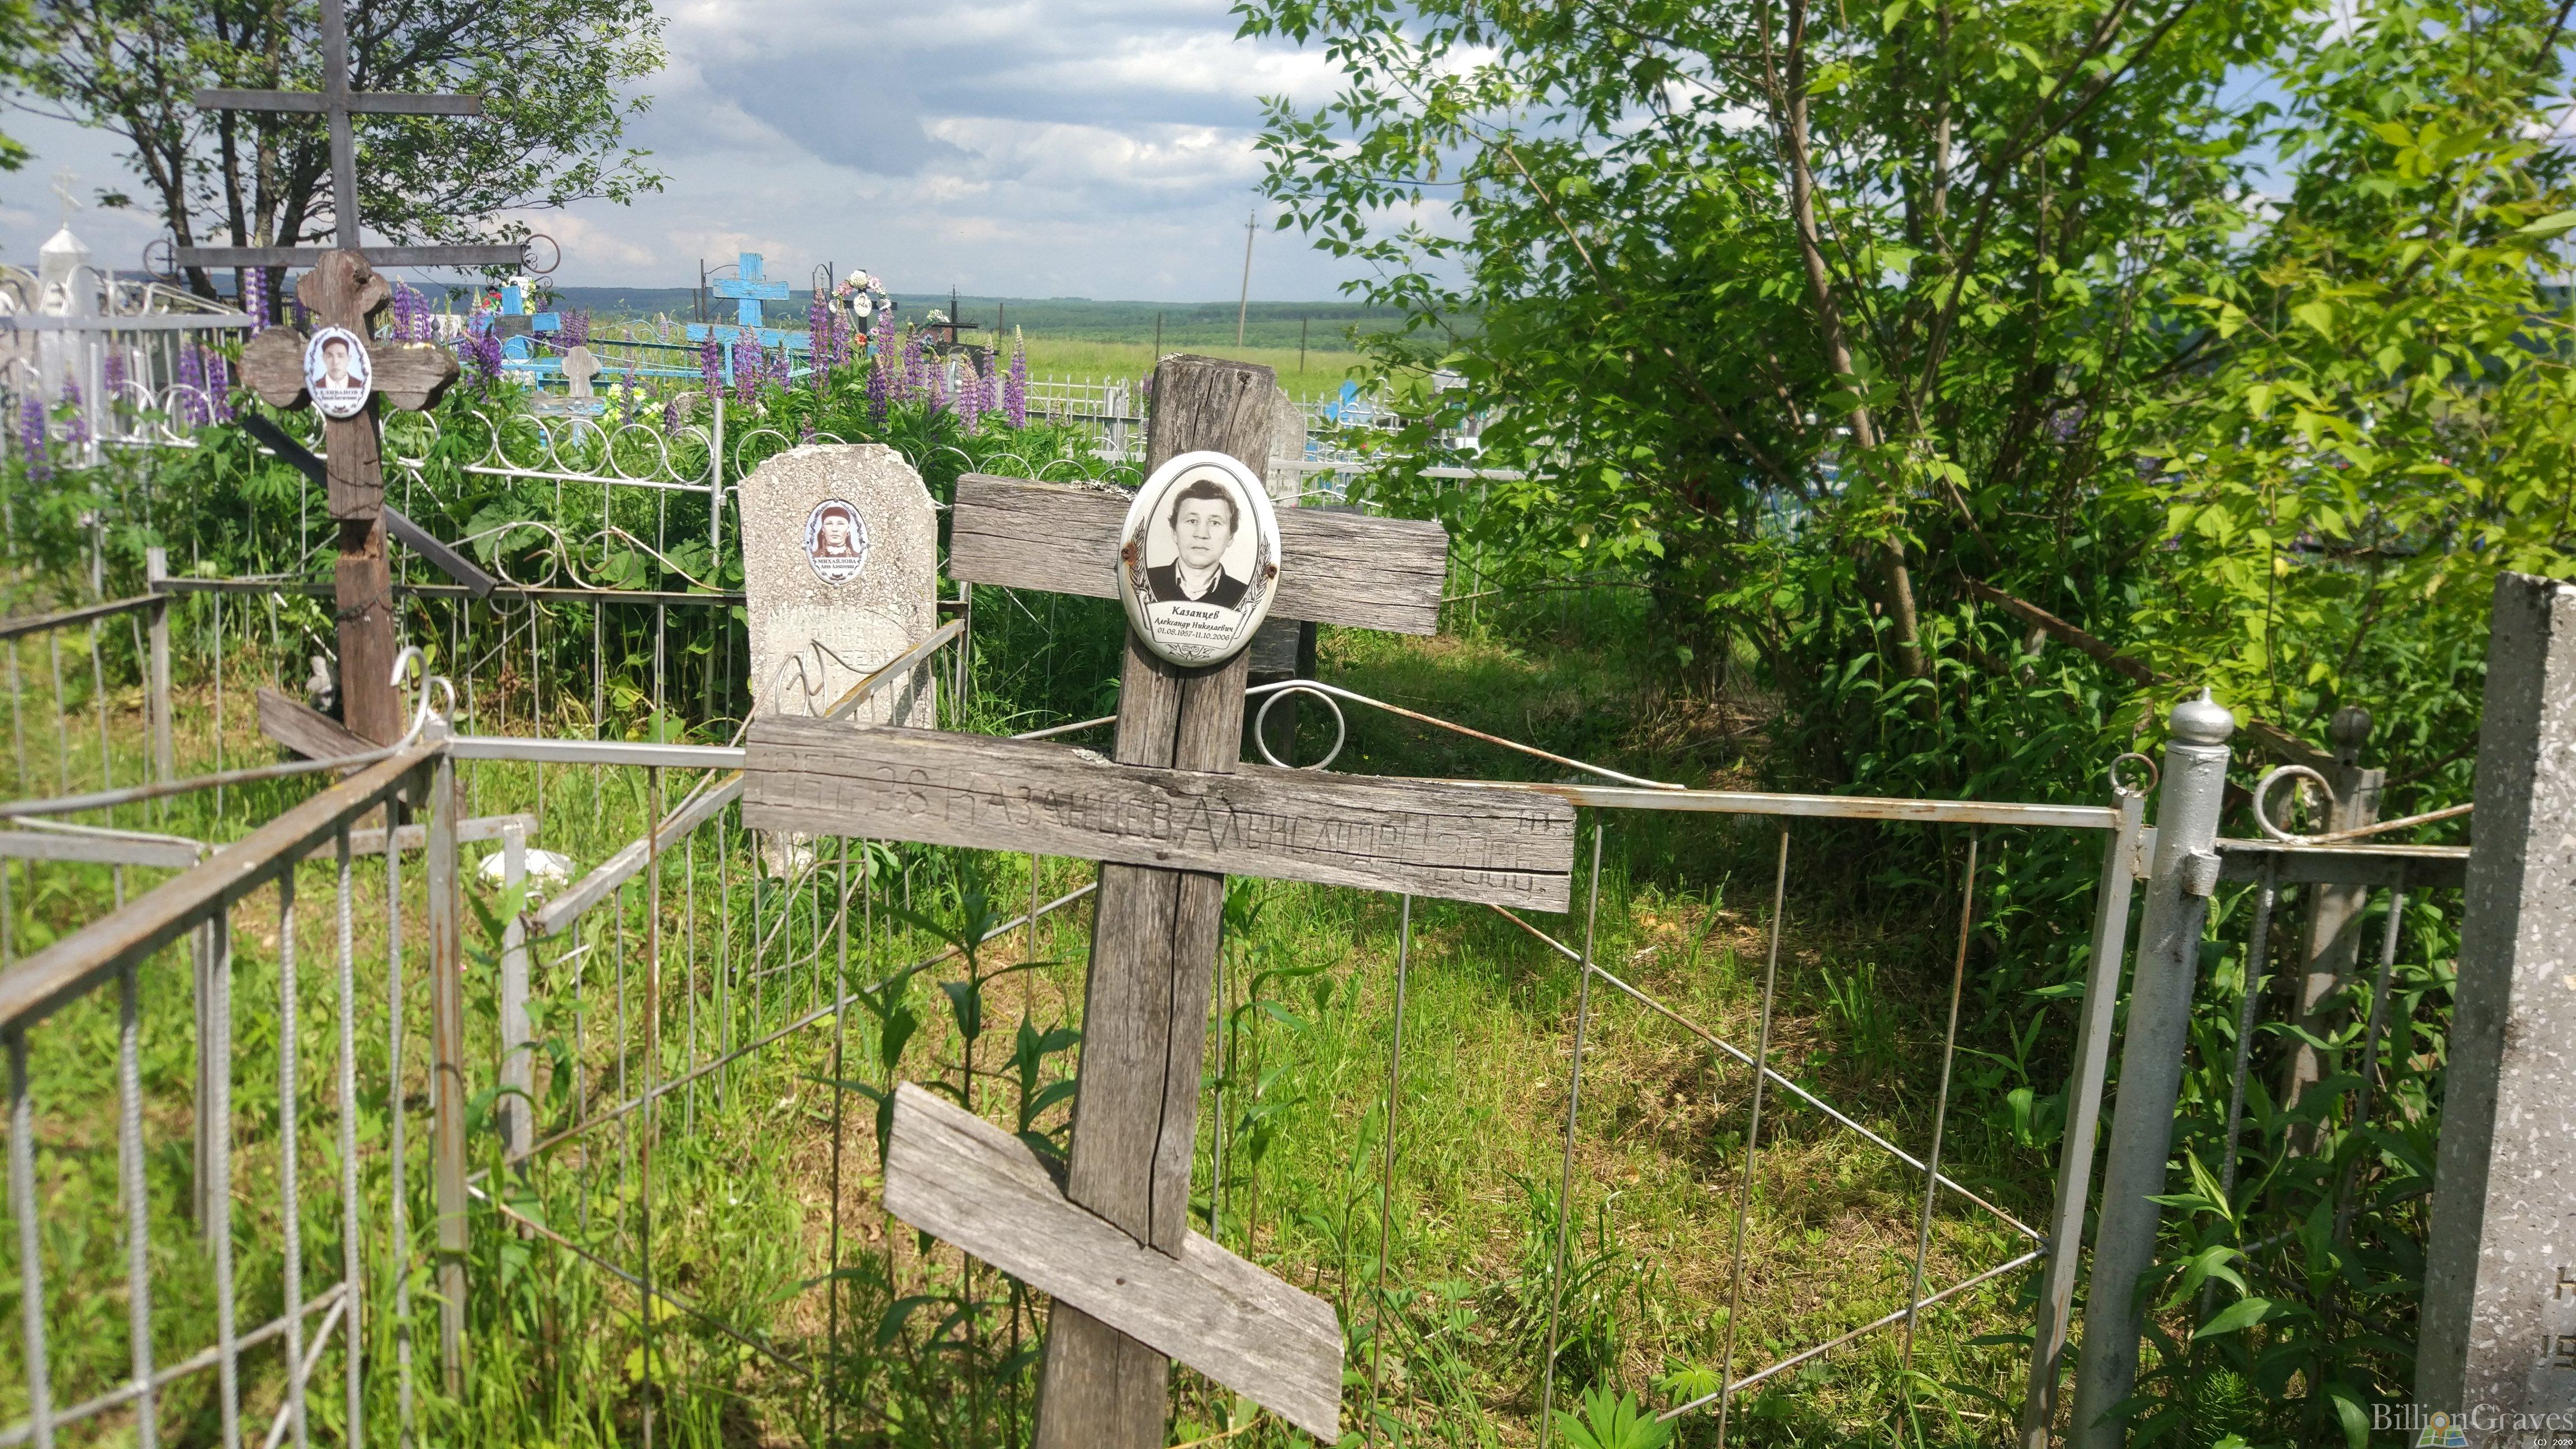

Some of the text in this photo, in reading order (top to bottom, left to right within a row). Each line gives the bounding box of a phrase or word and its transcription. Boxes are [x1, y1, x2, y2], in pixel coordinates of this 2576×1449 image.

[1172, 605, 1220, 620] Казанцев
[1154, 617, 1234, 632] Александр Николаевич
[1157, 627, 1230, 642] 01.08.1957-11.10.2006
